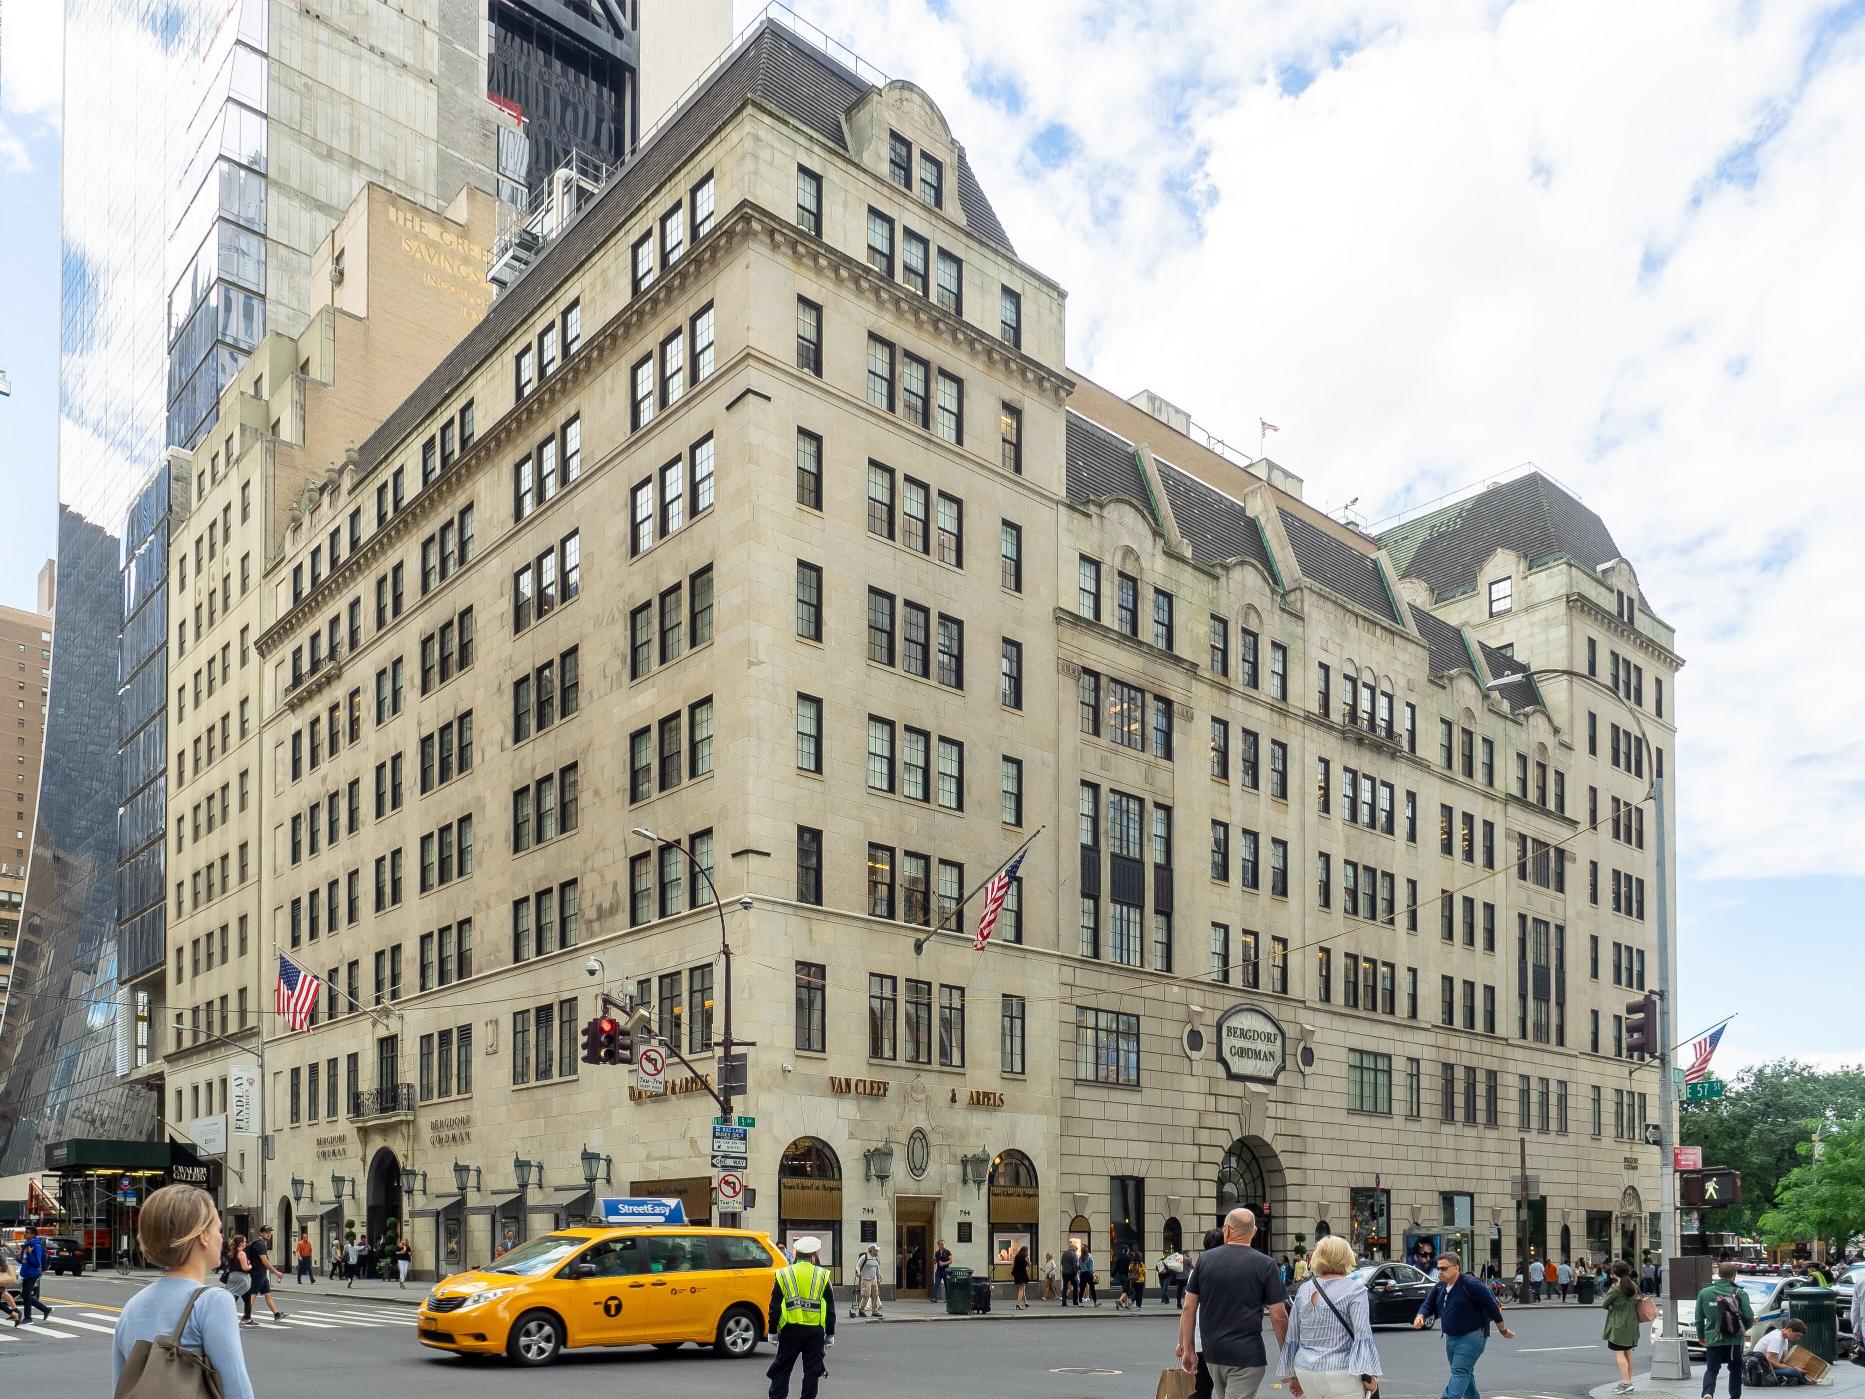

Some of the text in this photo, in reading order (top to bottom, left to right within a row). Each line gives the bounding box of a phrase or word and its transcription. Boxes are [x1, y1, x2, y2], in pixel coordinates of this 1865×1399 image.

[388, 205, 428, 236] THE
[1226, 1025, 1278, 1044] BERGDORF
[1229, 1046, 1275, 1061] GOODMAN
[830, 1076, 852, 1094] VAN
[855, 1079, 889, 1098] CLEEF
[968, 1090, 1004, 1107] ARPELS
[1687, 1085, 1692, 1097] E
[1697, 1084, 1709, 1097] 57
[234, 1074, 245, 1130] FINDLAY
[430, 1115, 471, 1131] BERGDORF
[741, 1117, 745, 1126] 5
[173, 1165, 207, 1174] CAVALIER
[173, 1172, 207, 1181] GALLERY
[618, 1203, 671, 1216] StreetEasy
